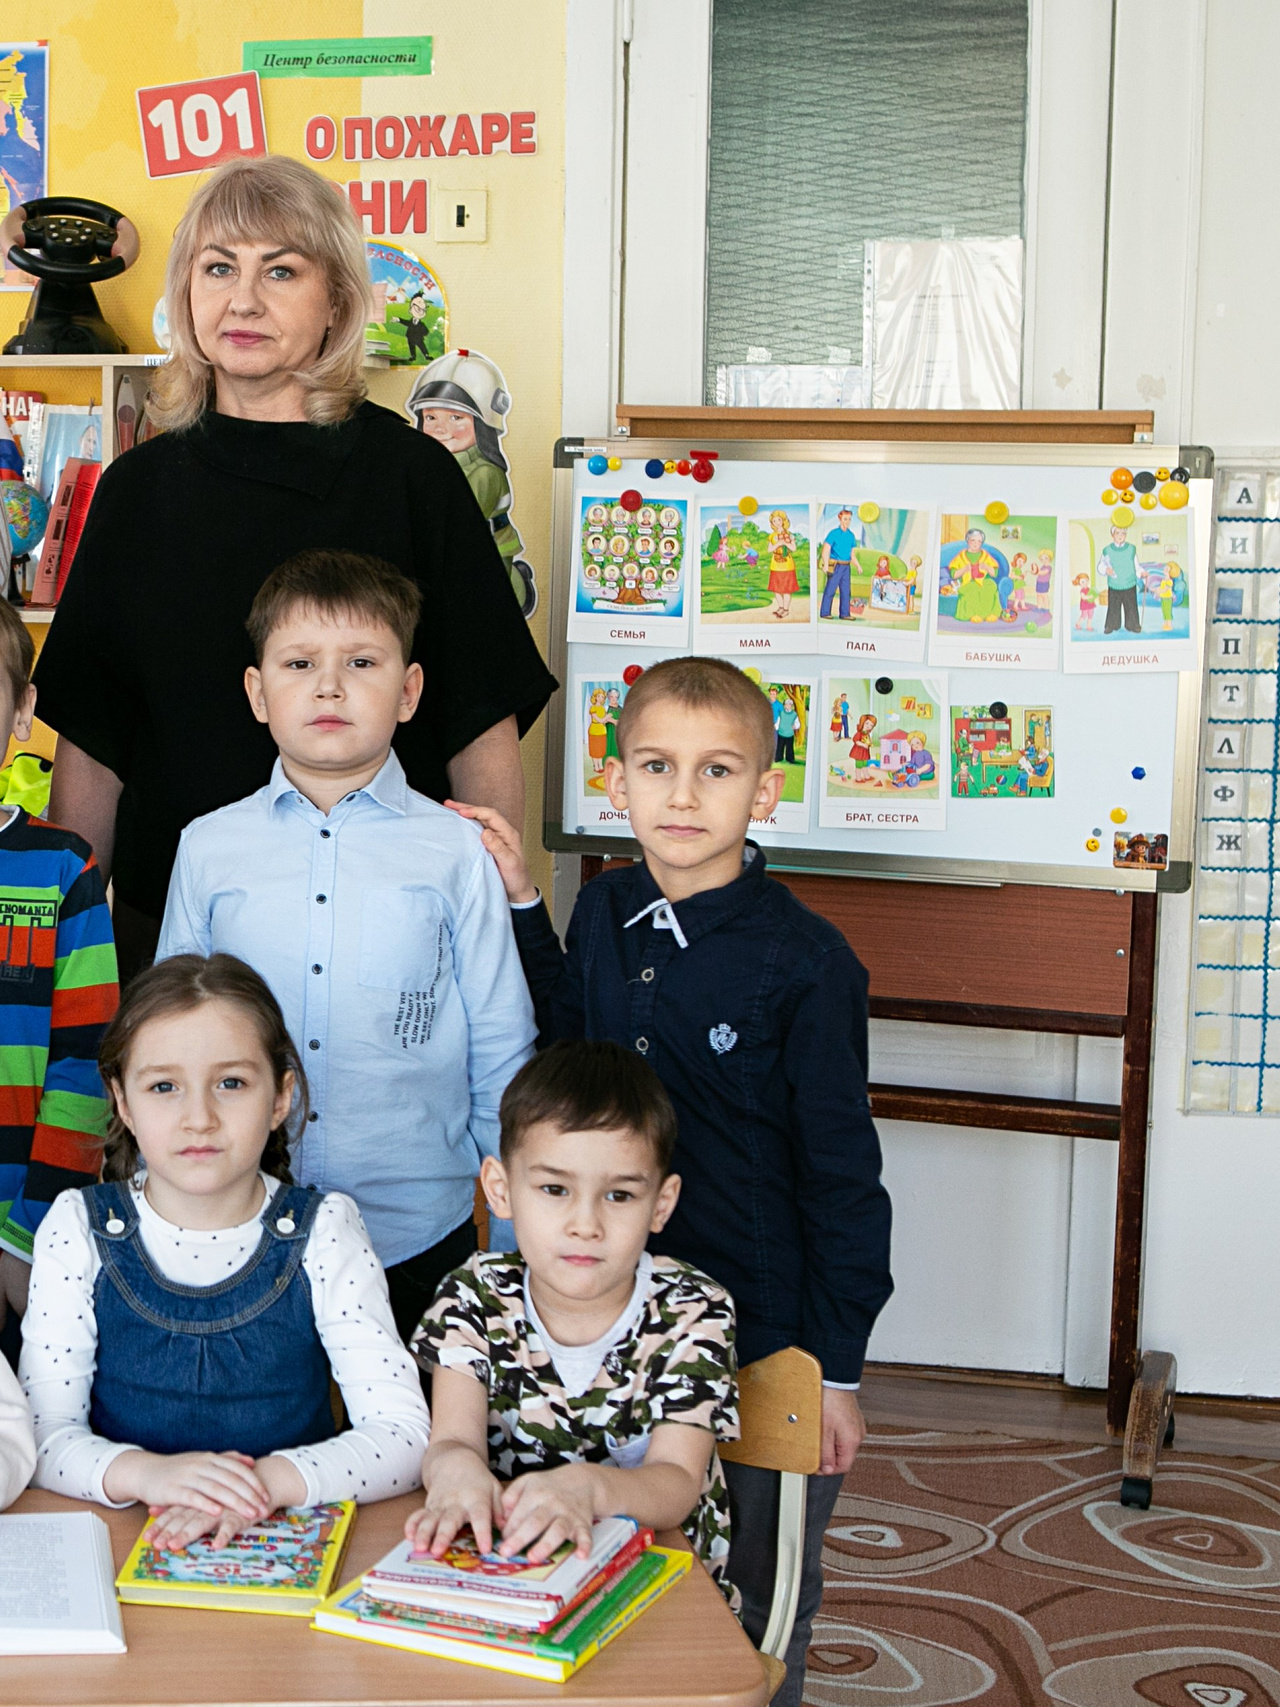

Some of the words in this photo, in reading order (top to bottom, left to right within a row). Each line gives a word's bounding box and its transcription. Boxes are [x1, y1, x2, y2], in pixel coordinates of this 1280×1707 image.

[262, 52, 313, 69] Центр
[316, 50, 417, 66] безопасности
[147, 87, 255, 162] 101
[306, 116, 336, 161] О
[343, 112, 537, 161] ПОЖАРЕ
[336, 179, 428, 235] НИ
[1235, 487, 1254, 504] А
[1229, 537, 1248, 555] И
[609, 629, 646, 640] СЕМЬЯ
[739, 639, 771, 648] МАМА
[846, 641, 877, 652] ПАПА
[1222, 637, 1241, 655] П
[965, 652, 1022, 663] БАБУШКА
[1101, 655, 1160, 667] ДЕДУШКА
[1223, 685, 1240, 702] Т
[1213, 785, 1235, 802] Ф
[845, 812, 874, 824] БРАТ,
[877, 813, 920, 824] СЕСТРА
[1216, 834, 1242, 851] Ж
[395, 1006, 405, 1022] BEST
[402, 1019, 410, 1035] YOU
[406, 998, 414, 1020] READY
[411, 1024, 420, 1044] SLOW
